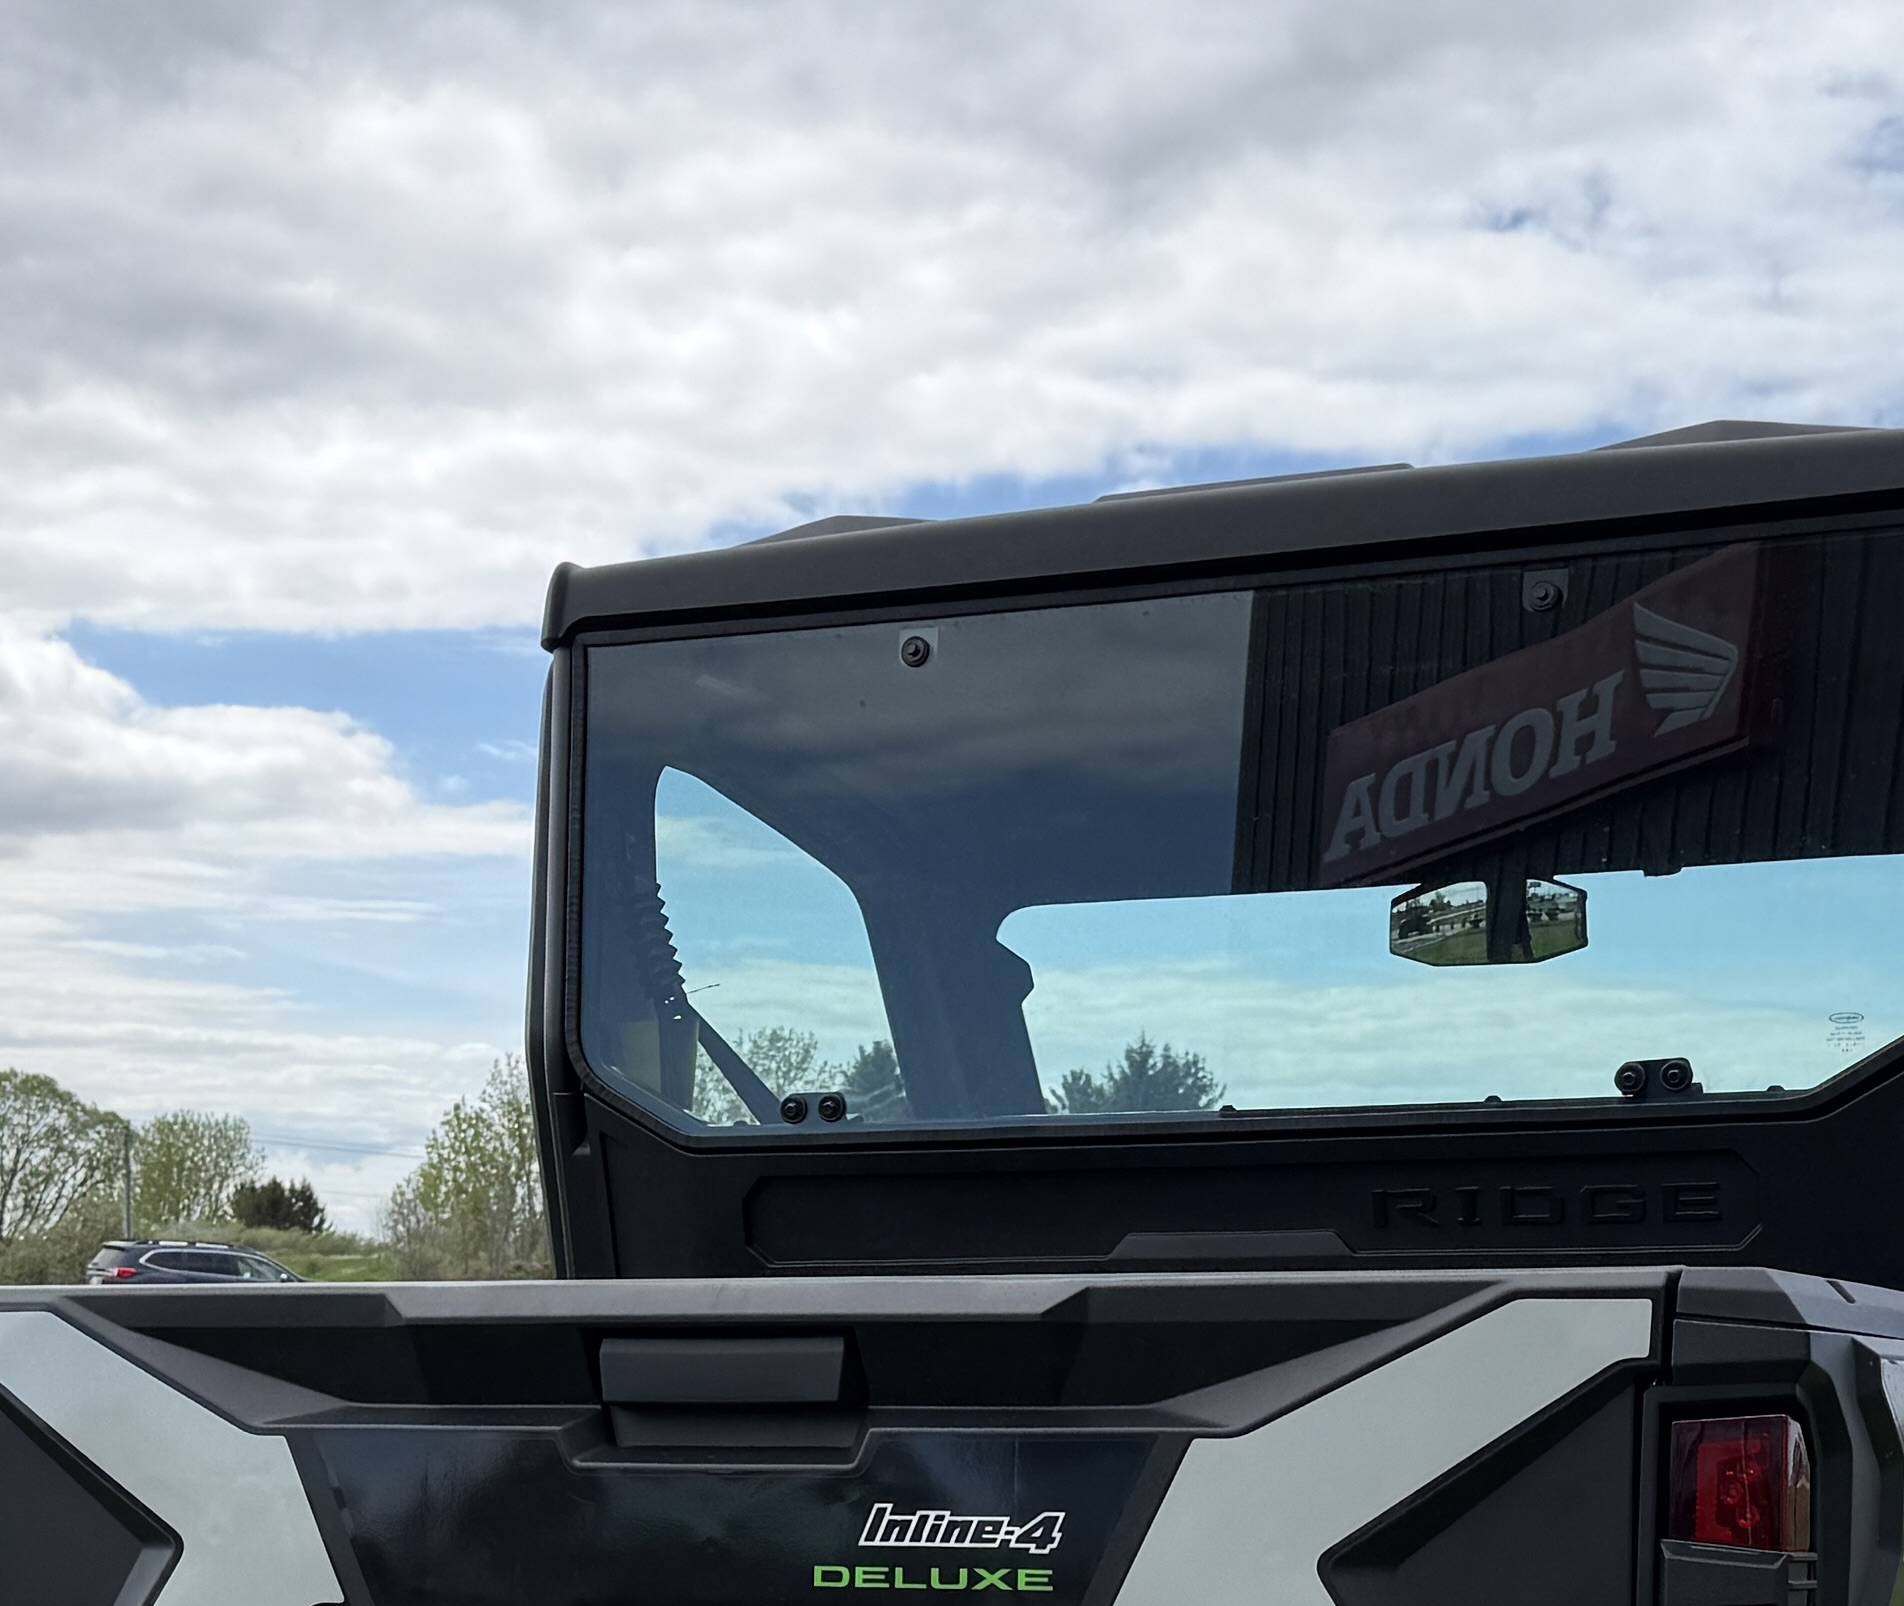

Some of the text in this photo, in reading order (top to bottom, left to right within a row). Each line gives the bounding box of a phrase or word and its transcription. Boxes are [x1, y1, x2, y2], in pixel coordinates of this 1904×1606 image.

[1372, 1183, 1723, 1227] RIDGE
[859, 1504, 1065, 1554] Inline-4
[813, 1565, 1053, 1592] DELUXE
